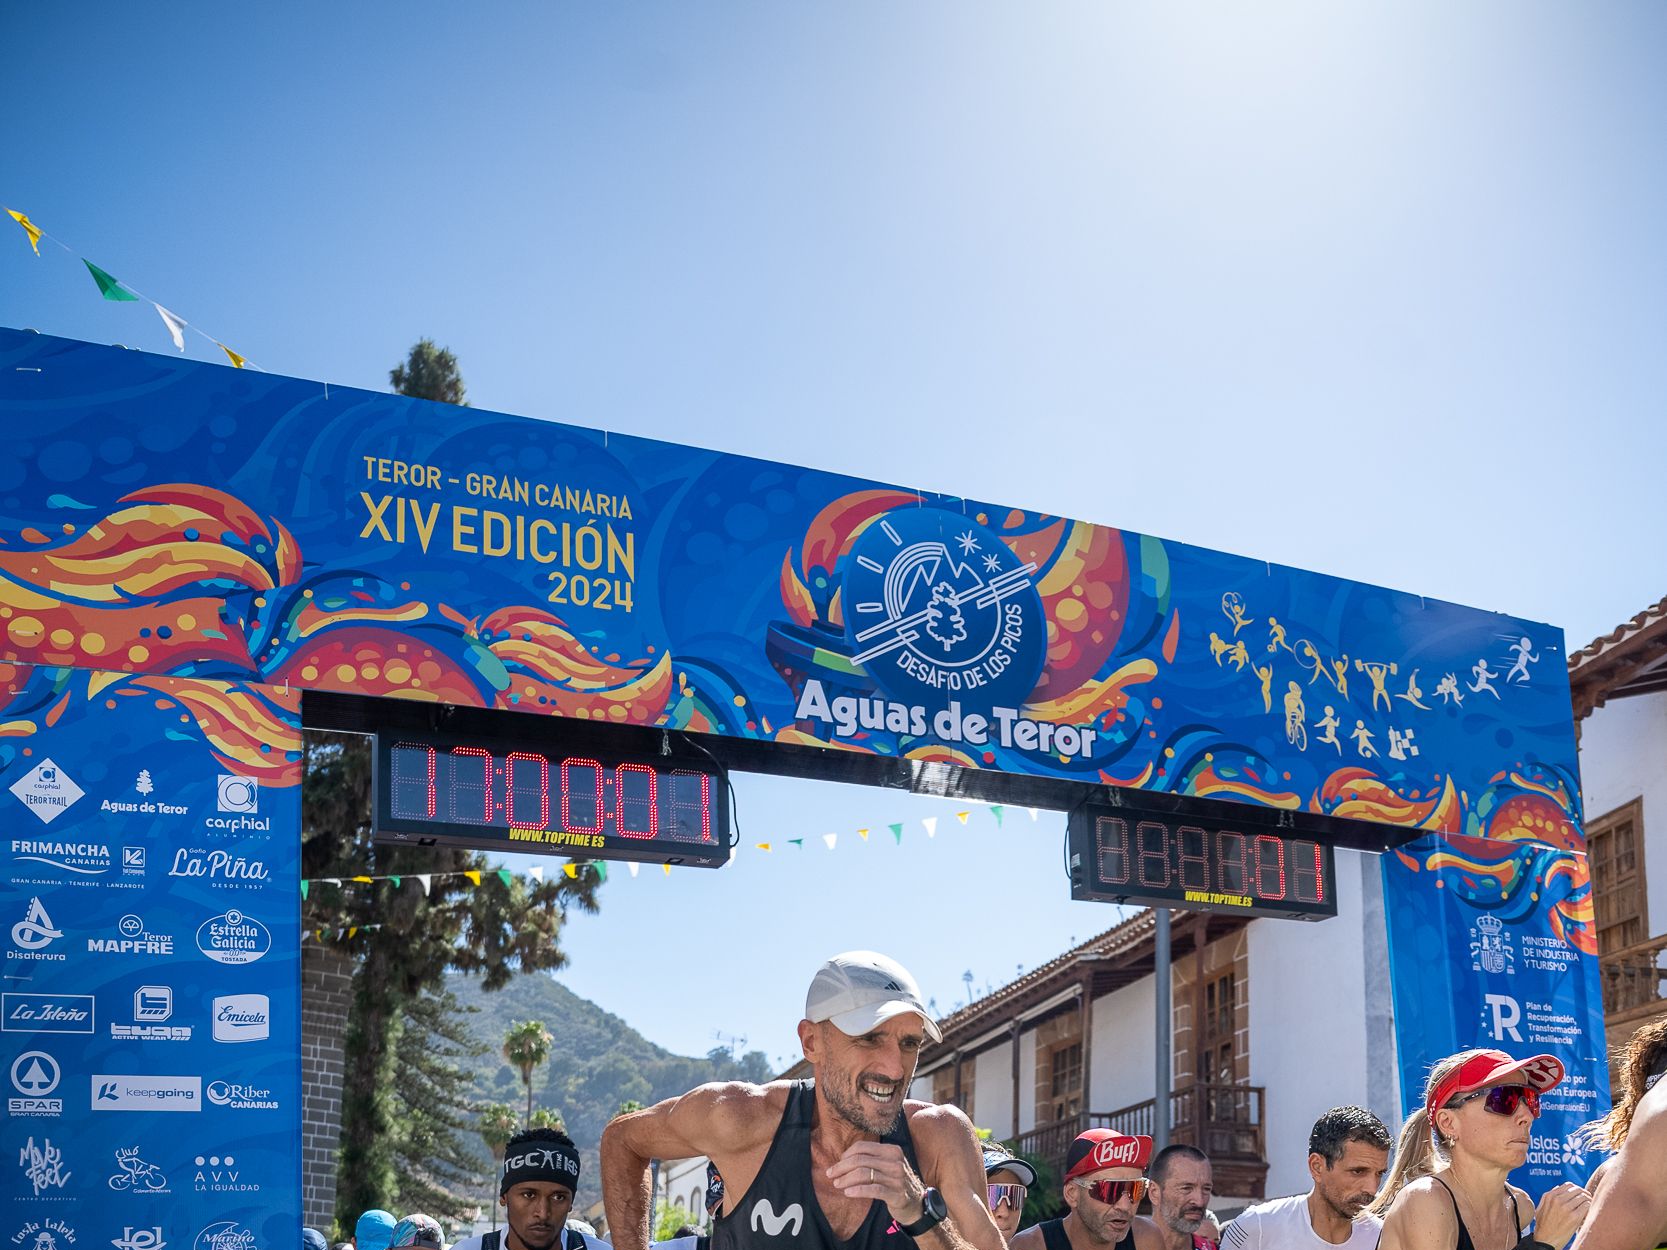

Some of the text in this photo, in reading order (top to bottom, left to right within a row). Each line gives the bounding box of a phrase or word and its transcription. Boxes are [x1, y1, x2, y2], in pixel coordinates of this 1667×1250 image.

[363, 455, 633, 520] TEROR GRAN CANARIA
[359, 491, 635, 584] XIV EDICIÓN
[547, 571, 633, 613] 2024
[964, 668, 987, 690] DE
[986, 649, 1012, 679] LOS
[1003, 603, 1022, 653] PICOS
[795, 678, 1097, 758] Aguas de Teror
[101, 800, 188, 815] Aguas de Teror
[205, 816, 270, 832] carphial
[11, 840, 110, 857] FRIMANCHA
[64, 858, 110, 866] CANARIAS
[168, 848, 269, 879] La Piña
[142, 932, 173, 942] Teror
[209, 923, 258, 937] Estrella
[88, 938, 174, 955] MAPFRE
[211, 936, 256, 949] Galicia
[1522, 935, 1567, 949] MINISTERIO
[6, 950, 66, 961] Disaterura
[1522, 947, 1580, 961] DE INDUSTRIA
[1523, 959, 1567, 972] Y TURISMO
[10, 1003, 88, 1021] La Isleña
[1526, 1001, 1552, 1011] Plan de
[217, 1006, 266, 1024] Emicela
[1528, 1022, 1582, 1034] Transformación
[1529, 1034, 1573, 1045] y Resiliencia
[1573, 1075, 1587, 1084] por
[126, 1088, 194, 1099] keepgoing
[230, 1084, 271, 1099] Riber
[1563, 1087, 1597, 1098] Europea
[10, 1101, 61, 1110] SPAR
[230, 1101, 279, 1109] CANARIAS
[1530, 1134, 1560, 1150] Islas
[504, 1152, 541, 1173] TGC
[202, 1233, 255, 1243] Marino
